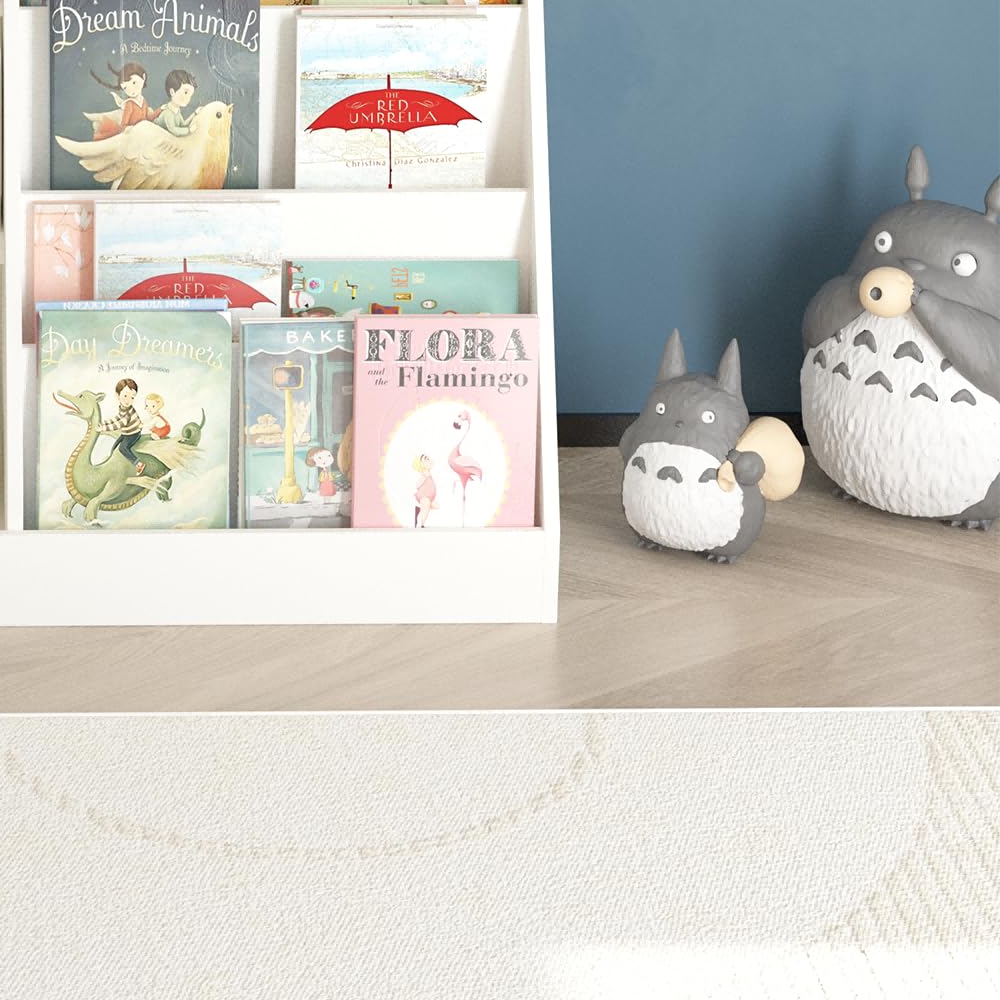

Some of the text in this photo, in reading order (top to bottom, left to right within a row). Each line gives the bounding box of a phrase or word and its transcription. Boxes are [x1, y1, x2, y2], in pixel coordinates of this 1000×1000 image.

[52, 0, 145, 54] Dream
[131, 42, 162, 54] Bedtime
[164, 42, 192, 58] Journey
[377, 100, 409, 111] RED
[350, 111, 438, 126] UMBRELLA
[346, 160, 386, 168] Christina
[417, 156, 457, 164] Gonzalez
[174, 283, 205, 294] RED
[40, 320, 223, 370] Day Dreamers
[363, 327, 533, 362] FLORA
[367, 367, 385, 376] and
[374, 377, 388, 386] the
[398, 366, 528, 393] Flamingo
